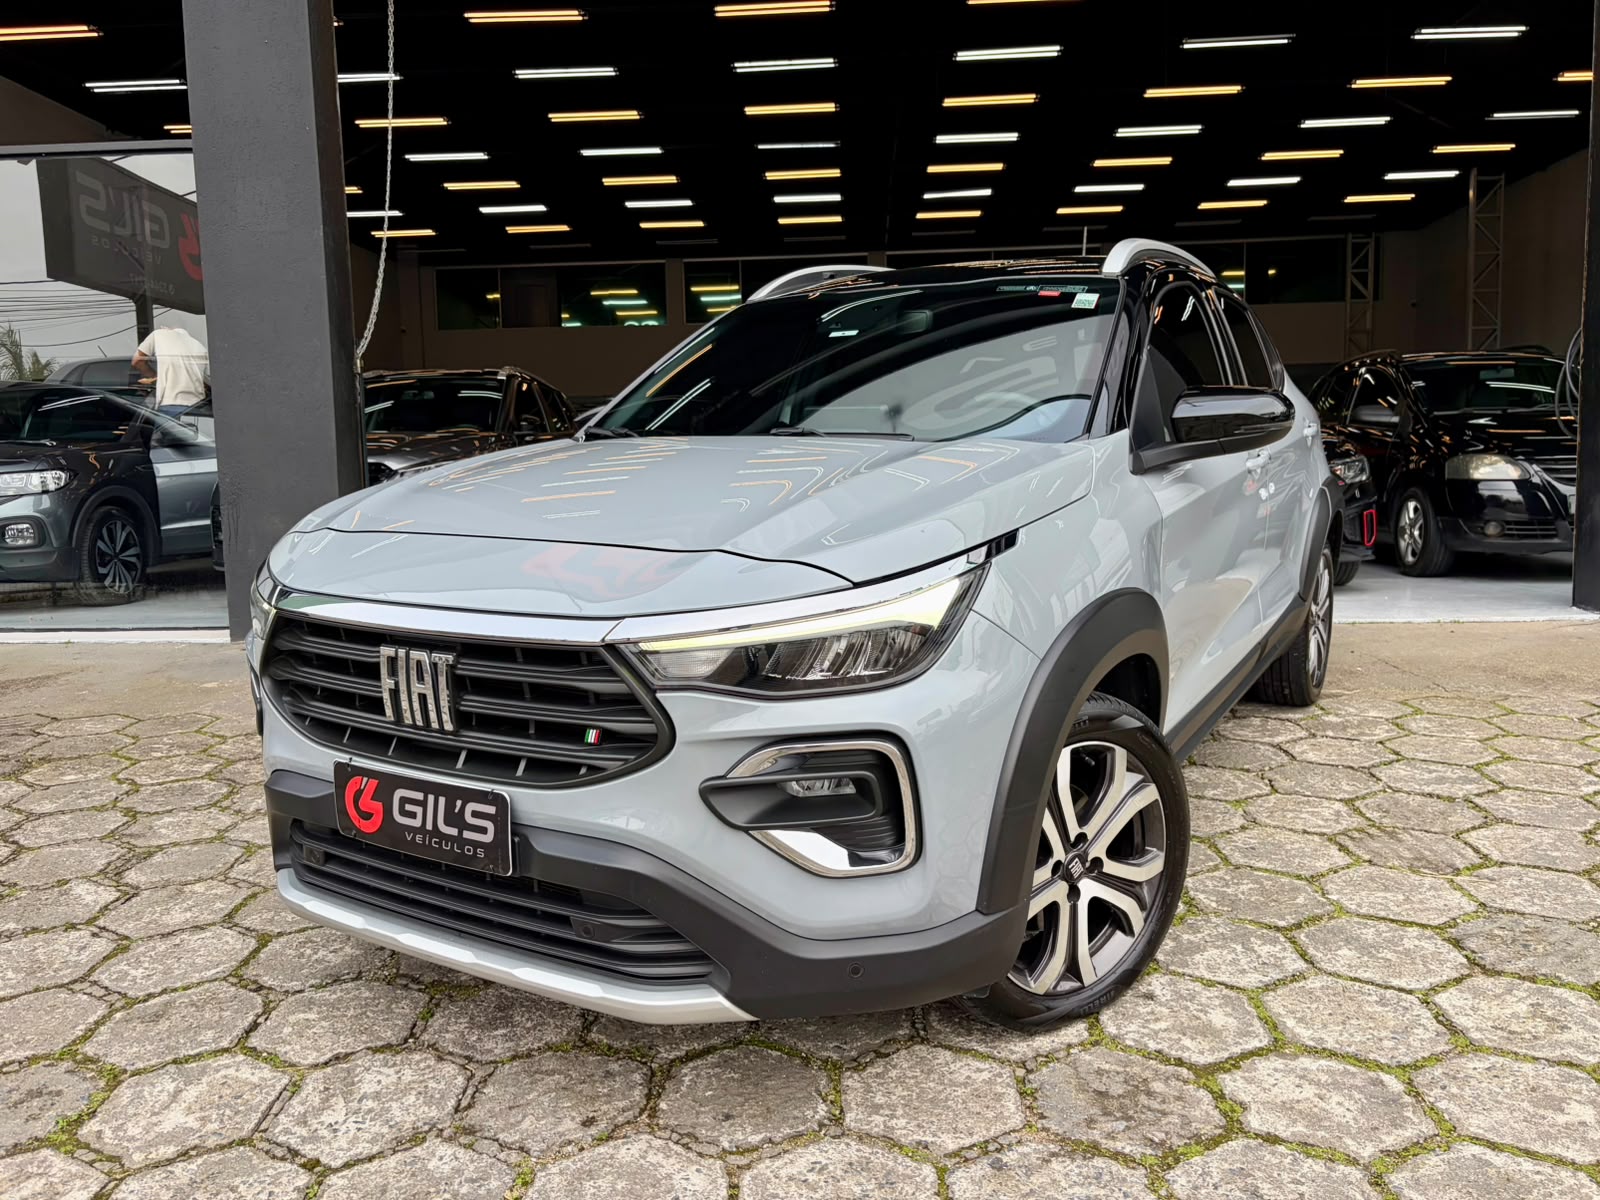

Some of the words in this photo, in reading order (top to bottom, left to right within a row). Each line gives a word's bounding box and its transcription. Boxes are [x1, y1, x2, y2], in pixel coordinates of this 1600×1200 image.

[379, 645, 455, 732] FIAT
[392, 788, 497, 843] GIL'S
[405, 831, 485, 858] VEÍCULOS
[1068, 857, 1084, 879] FIAT
